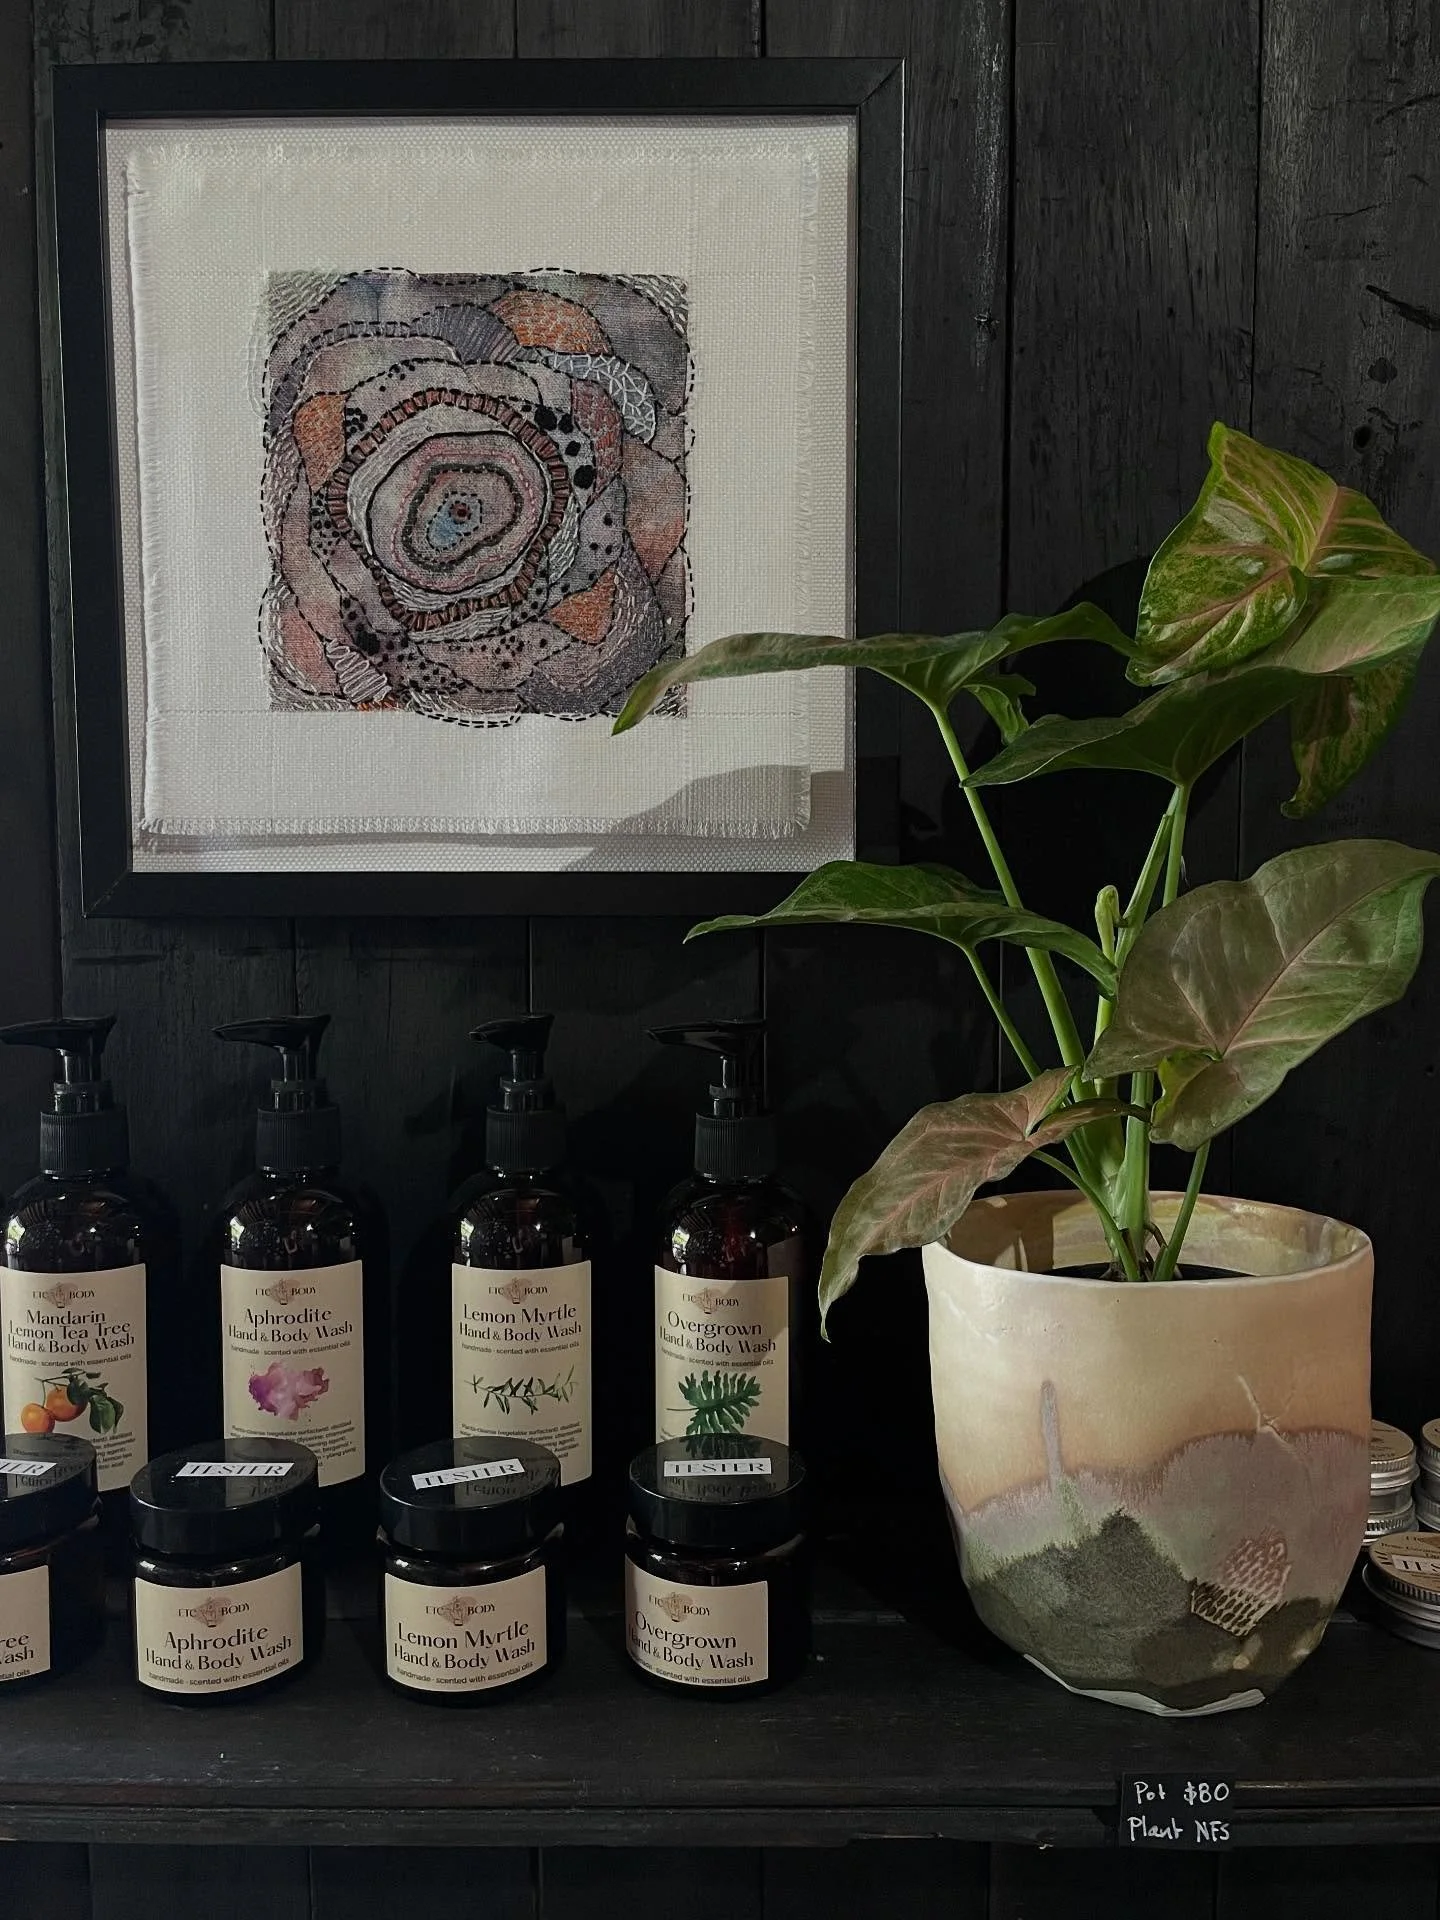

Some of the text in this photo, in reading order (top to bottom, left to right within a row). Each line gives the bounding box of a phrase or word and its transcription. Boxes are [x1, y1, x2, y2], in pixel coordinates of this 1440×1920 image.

[68, 1290, 97, 1300] BODY
[291, 1286, 316, 1296] BODY
[524, 1286, 548, 1295] BODY
[715, 1298, 740, 1307] BODY
[26, 1309, 106, 1325] Mandarin
[244, 1308, 333, 1328] Aphrodite
[463, 1303, 577, 1325] Lemon Myrtle
[9, 1320, 131, 1340] Lemon Tea Tree
[228, 1320, 353, 1343] Hand & Body Wash
[459, 1321, 582, 1342] Hand & Body Wash
[667, 1310, 762, 1339] Overgrown
[8, 1333, 135, 1355] Hand & Body Wash
[659, 1325, 776, 1356] Hand & Body Wash
[70, 1359, 86, 1367] with
[188, 1465, 283, 1475] TESTER
[419, 1464, 518, 1486] TESTER
[670, 1463, 766, 1473] TESTER
[221, 1603, 250, 1617] BODY
[467, 1603, 496, 1616] BODY
[683, 1605, 711, 1616] BODY
[398, 1621, 529, 1649] Lemon Myrtle
[635, 1610, 737, 1650] Overgrown
[165, 1627, 269, 1654] Aphrodite
[628, 1624, 651, 1655] Hand
[653, 1647, 661, 1659] &
[663, 1647, 704, 1670] Body
[709, 1652, 754, 1669] Wash
[0, 1645, 34, 1665] ash
[146, 1635, 292, 1670] Hand & Body Wash
[394, 1638, 535, 1670] Hand & Body Wash
[223, 1674, 241, 1683] with
[468, 1675, 486, 1683] with
[683, 1674, 700, 1684] with
[1133, 1781, 1230, 1806] Pot $80
[1127, 1815, 1230, 1843] Plant NFS
